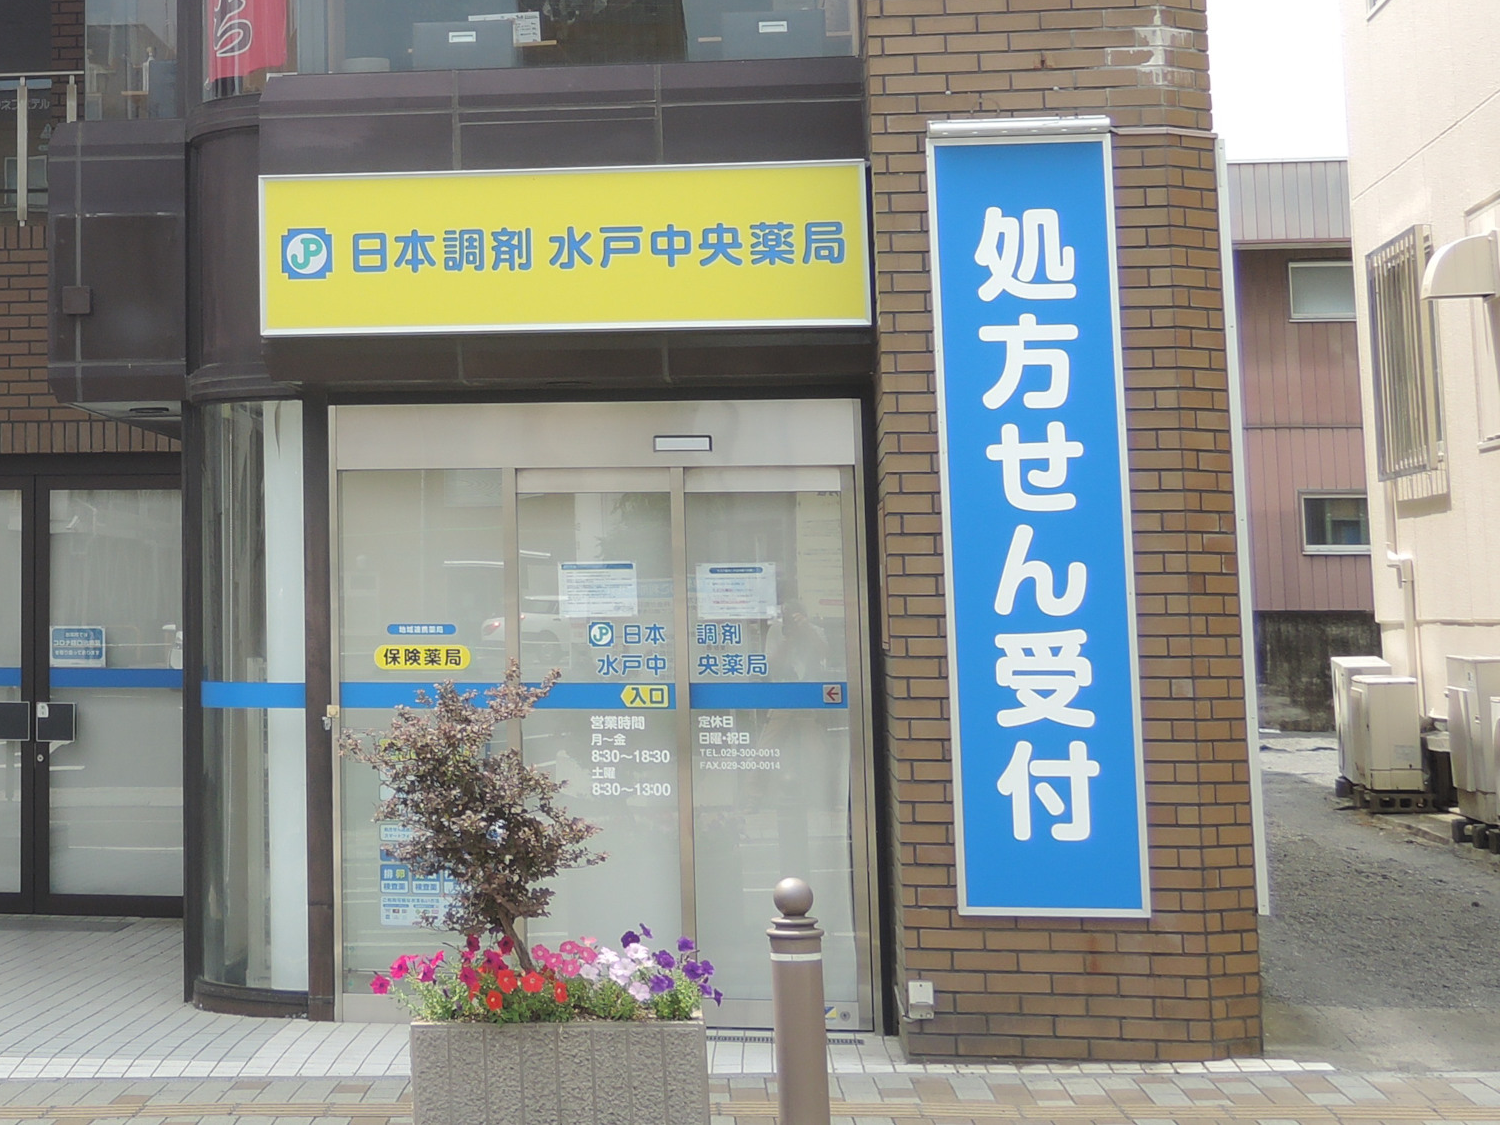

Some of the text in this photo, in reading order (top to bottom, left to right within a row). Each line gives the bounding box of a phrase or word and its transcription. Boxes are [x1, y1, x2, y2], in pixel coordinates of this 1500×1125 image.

[350, 225, 533, 273] 日本調剤
[548, 220, 847, 271] 水戸中央薬局
[974, 205, 1101, 842] 処方せん受付
[623, 623, 667, 646] 日本
[696, 623, 742, 646] 調剤
[383, 648, 462, 667] 保険薬局
[597, 653, 768, 677] 水戸中 央薬局
[629, 686, 665, 705] 入口
[590, 715, 646, 731] 営業時間
[698, 715, 735, 729] 定休日
[591, 766, 616, 780] 土曜
